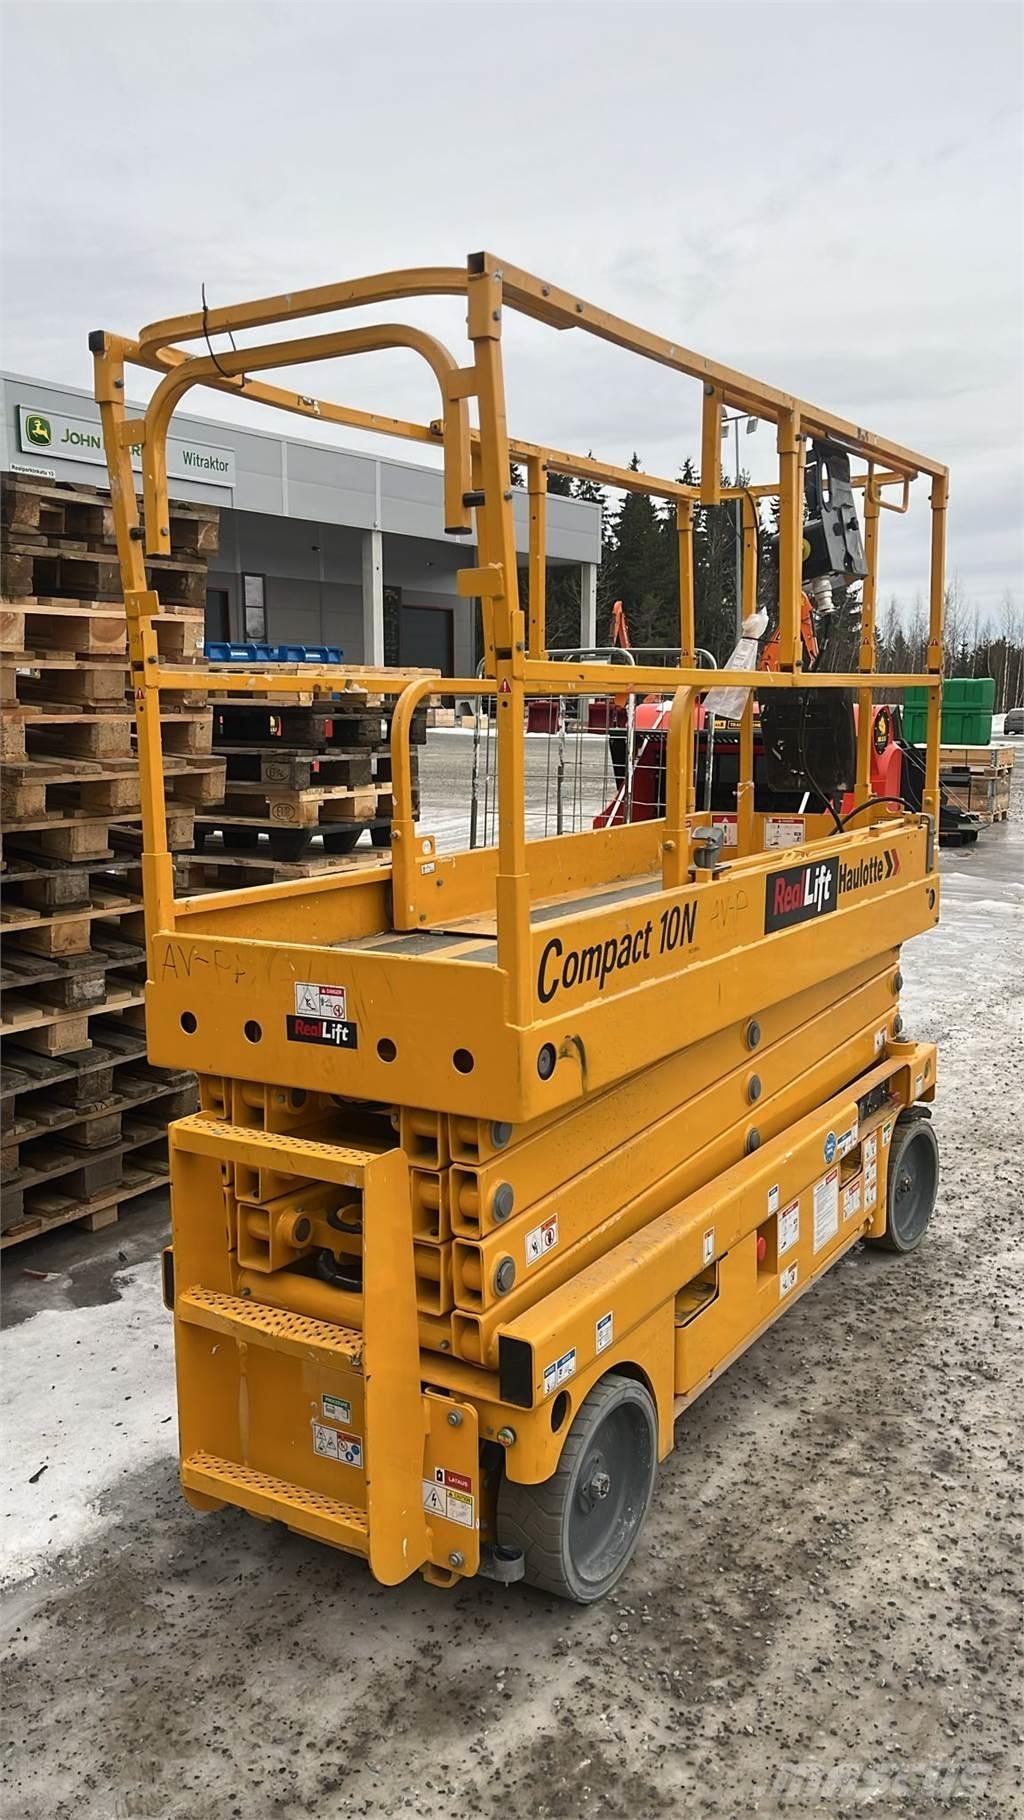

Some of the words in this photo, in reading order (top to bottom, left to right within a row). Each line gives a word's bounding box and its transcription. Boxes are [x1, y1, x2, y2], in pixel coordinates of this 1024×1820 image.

[60, 428, 101, 449] JOHN
[182, 450, 229, 472] Witraktor
[772, 863, 832, 917] RealLift
[838, 858, 883, 895] Haulotte
[536, 919, 652, 1004] Compact
[659, 900, 698, 954] 10N
[295, 1018, 349, 1045] RealLift
[448, 1476, 469, 1487] LATAUS
